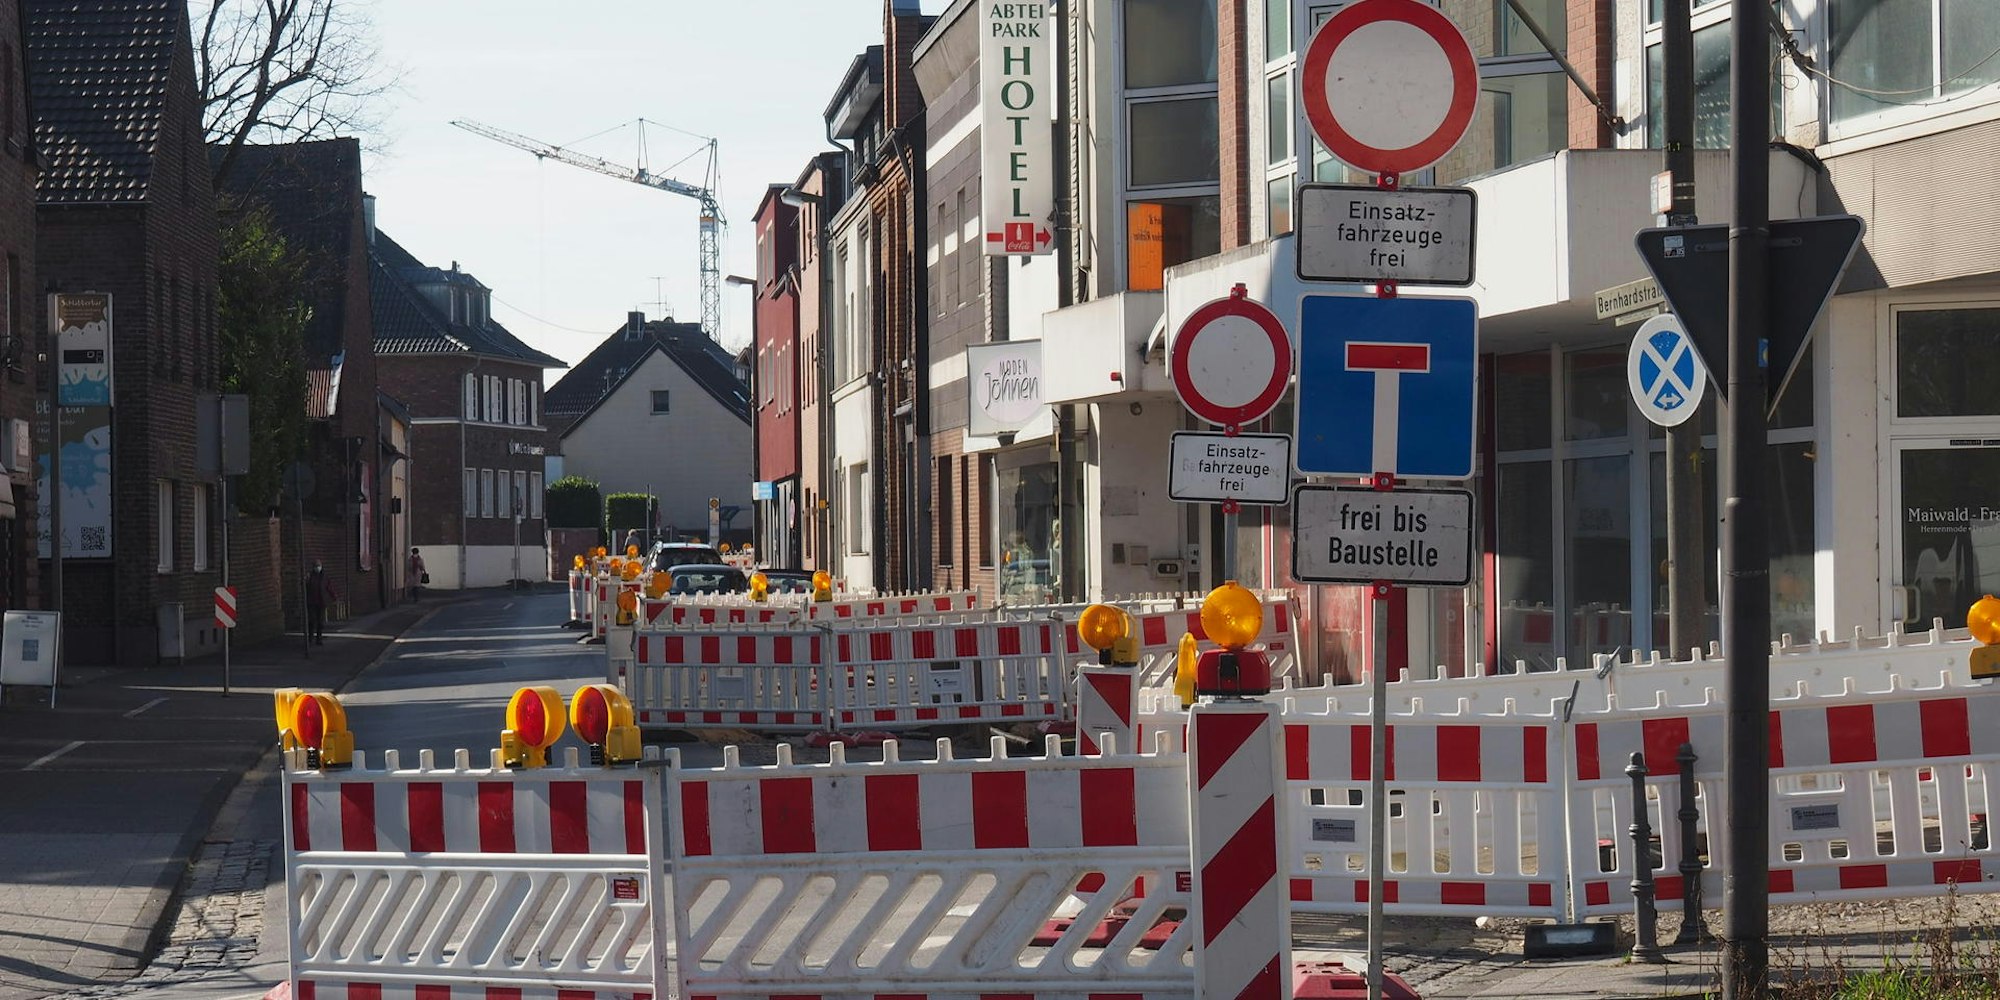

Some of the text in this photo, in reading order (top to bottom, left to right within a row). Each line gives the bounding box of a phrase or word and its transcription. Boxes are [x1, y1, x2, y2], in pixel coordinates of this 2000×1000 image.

[989, 3, 1044, 19] ABTEI
[992, 22, 1041, 38] PARK
[1001, 46, 1034, 217] HOTEL
[1349, 200, 1436, 222] Einsatz-
[1337, 223, 1443, 249] fahrzeuge
[1369, 248, 1406, 268] frei
[999, 359, 1028, 377] MODEN
[1206, 443, 1266, 459] Einsatz-
[1198, 459, 1270, 478] fahrzeuge
[1219, 477, 1244, 491] frei
[1340, 503, 1428, 533] frei bis
[1907, 507, 1969, 522] Maiwald
[1920, 525, 1967, 533] Herrenmode
[1328, 536, 1438, 567] Baustelle
